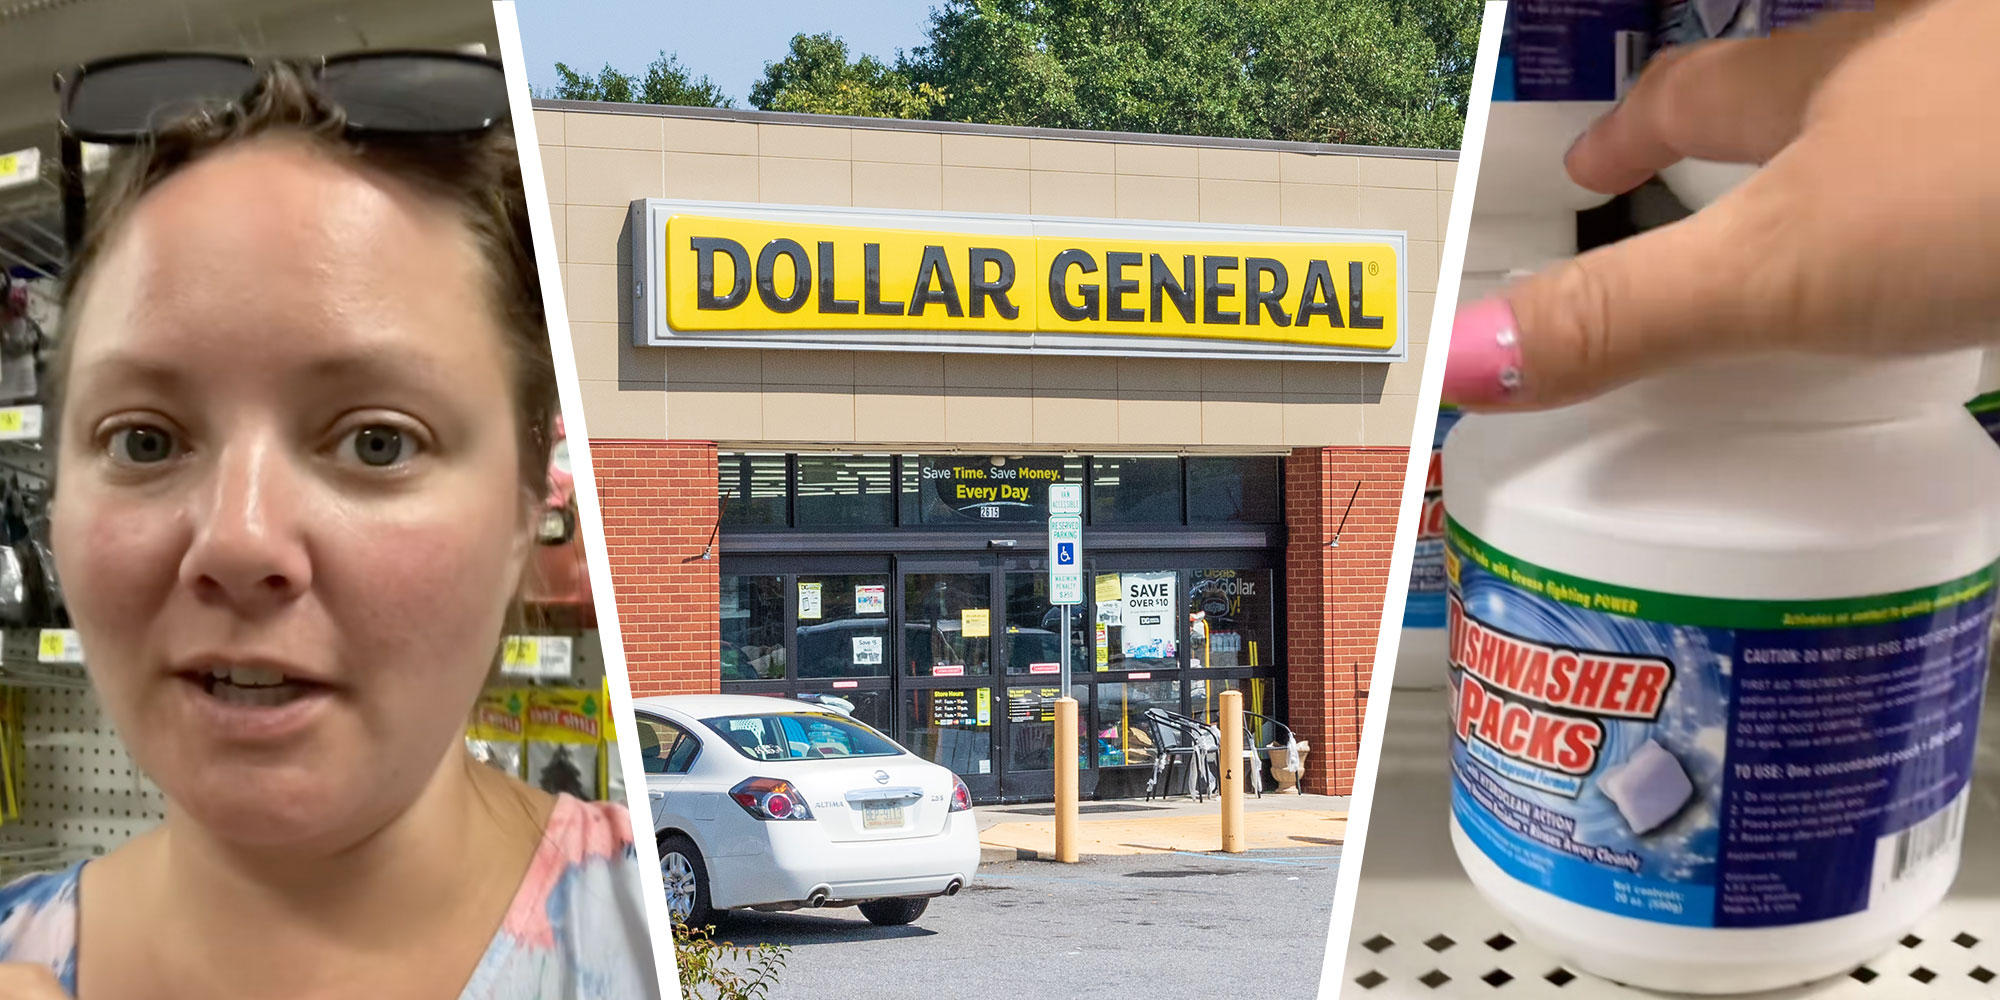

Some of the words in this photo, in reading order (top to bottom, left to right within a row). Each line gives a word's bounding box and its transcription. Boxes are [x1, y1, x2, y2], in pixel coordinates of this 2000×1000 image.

[690, 236, 1020, 321] DOLLAR
[1048, 248, 1384, 329] GENERAL
[922, 467, 950, 479] Save
[953, 466, 987, 479] Time.
[990, 467, 1017, 479] Save
[1018, 466, 1061, 481] Money.
[956, 484, 997, 501] Every
[1001, 484, 1031, 501] Day.
[1053, 500, 1079, 508] ACCESSIBLE
[981, 506, 999, 518] 2615
[1052, 522, 1079, 530] RESERVED
[1053, 531, 1078, 539] PARKING
[1130, 583, 1168, 598] SAVE
[1129, 599, 1154, 608] OVER
[1156, 598, 1169, 607] $10
[1594, 593, 1639, 614] POWER
[1449, 597, 1668, 715] DISHWASHER
[1743, 648, 1800, 664] CAUTION:
[1804, 649, 1820, 662] DO
[1822, 648, 1842, 662] NOT
[1457, 673, 1600, 770] PACKS
[1734, 763, 1751, 779] TO
[1753, 763, 1785, 780] USE:
[1787, 763, 1812, 778] One
[815, 800, 845, 808] ALTIMA
[1534, 805, 1575, 835] ACTION
[1564, 840, 1595, 864] Away
[1595, 845, 1642, 873] Cleanly
[1613, 879, 1631, 893] Net
